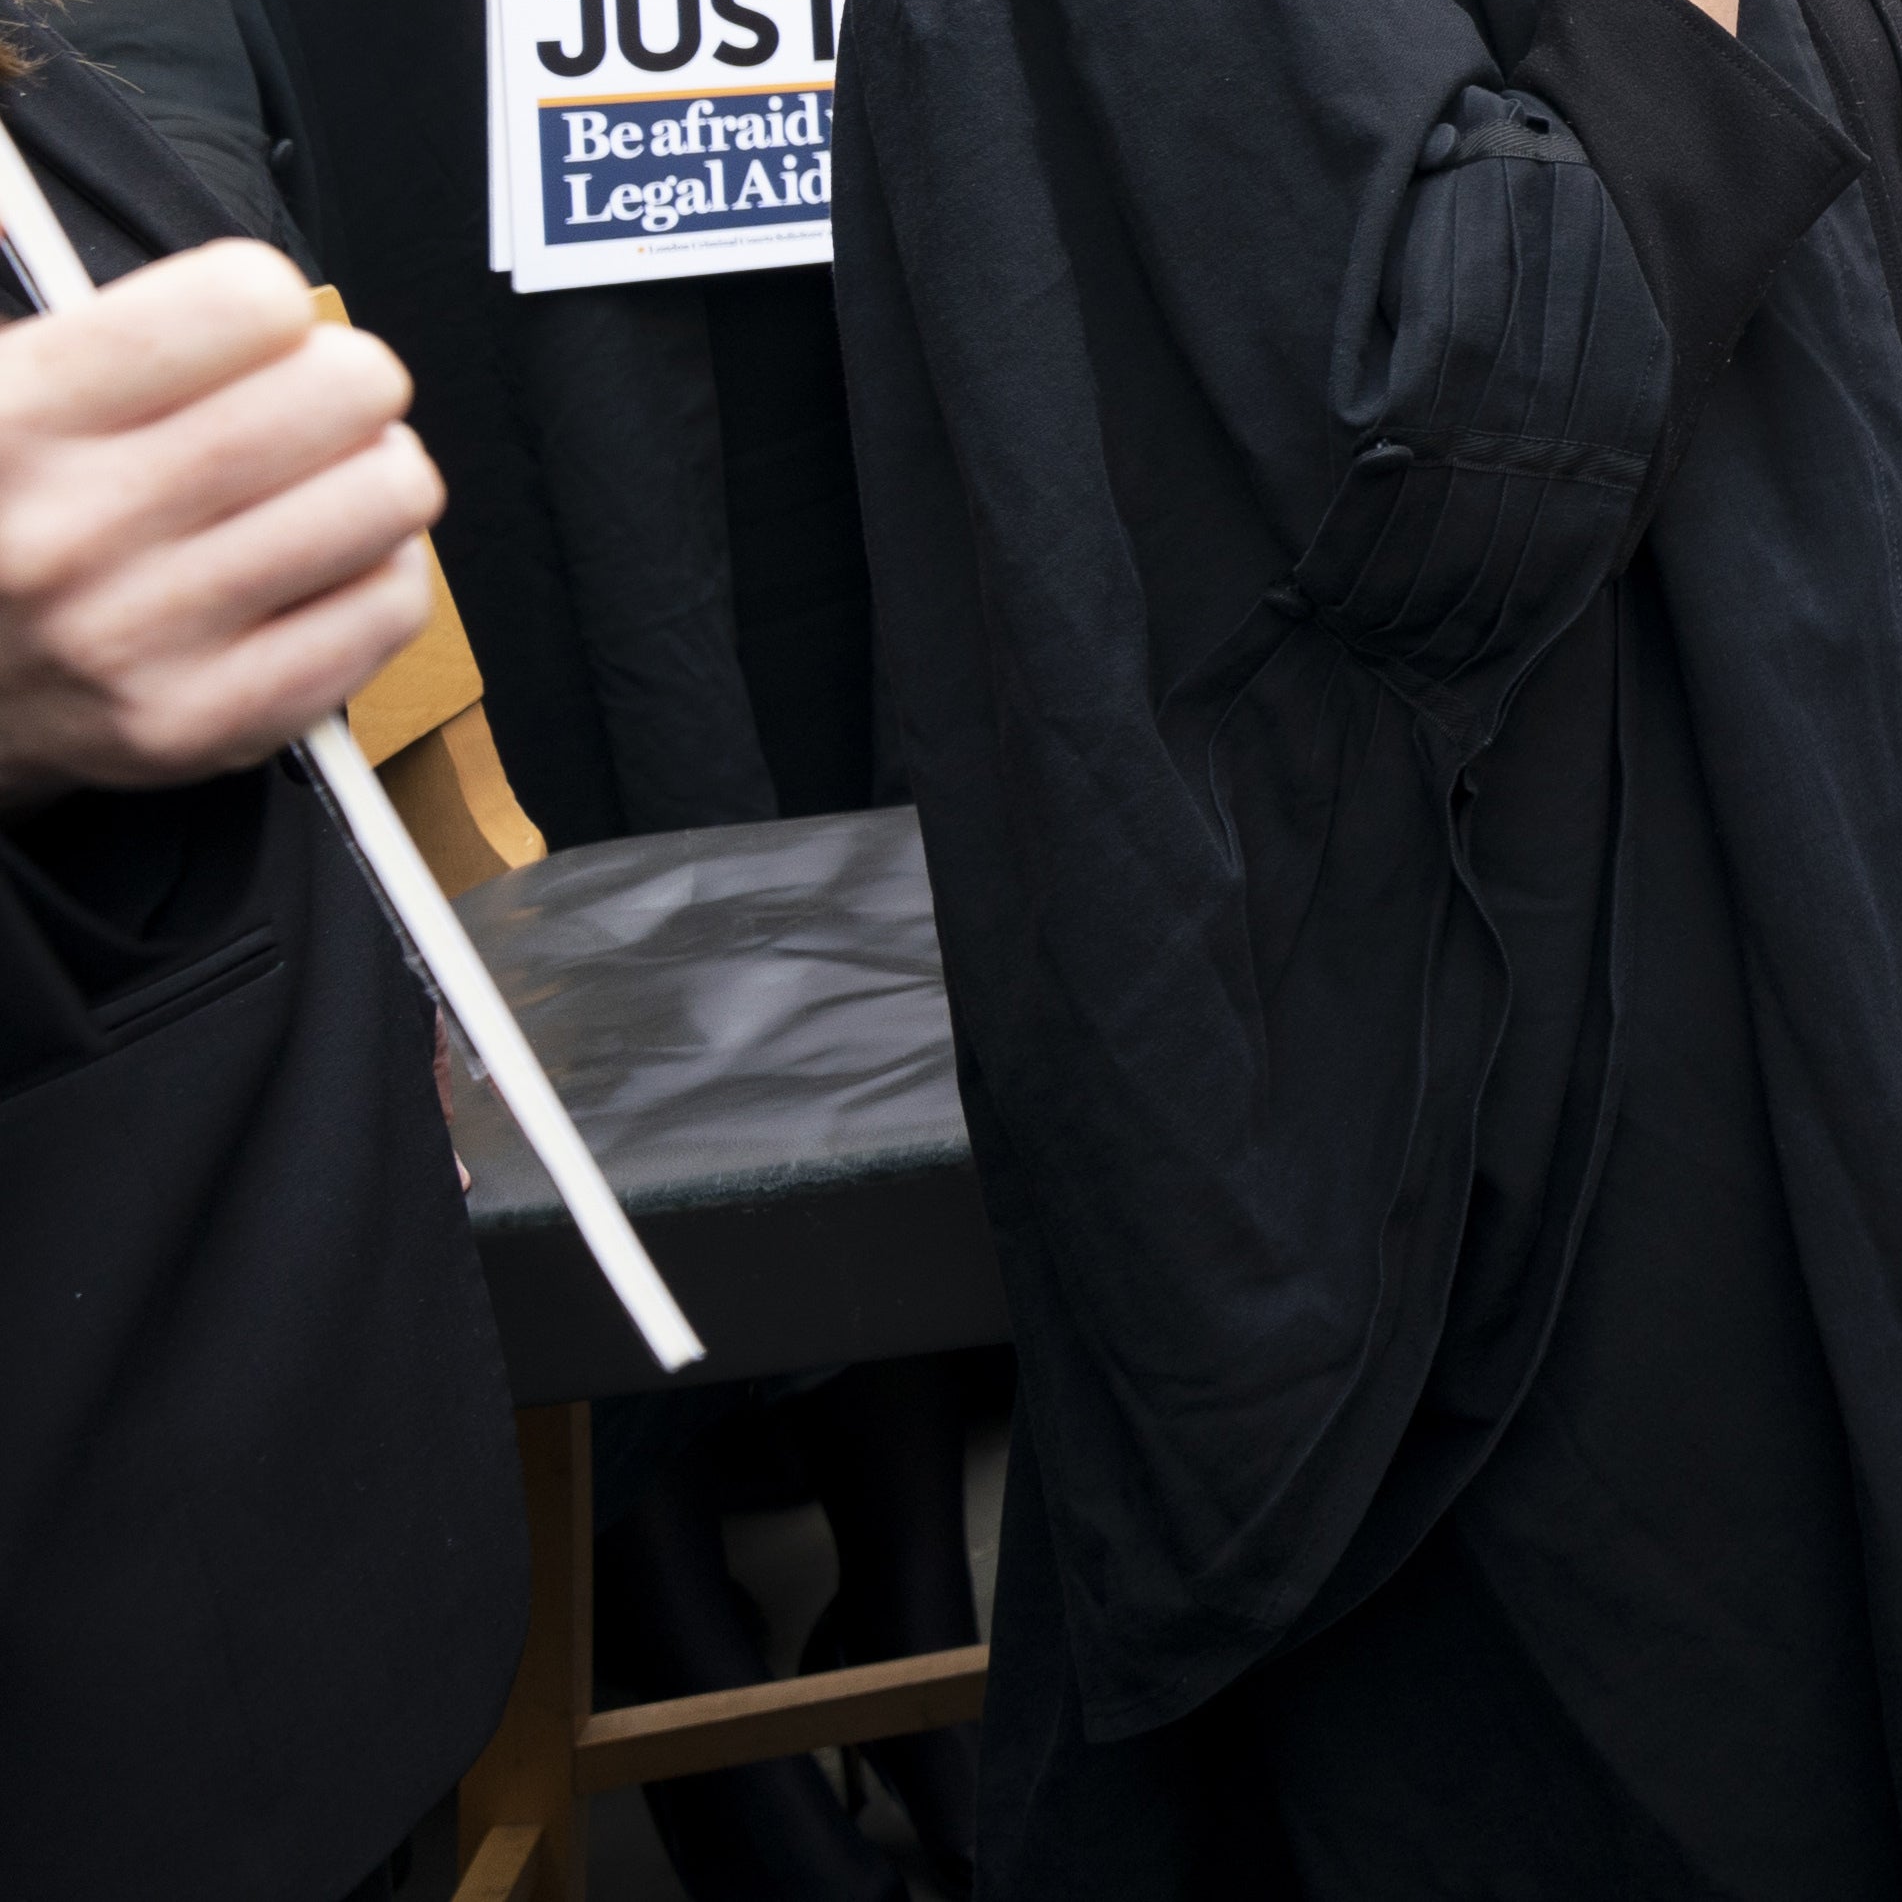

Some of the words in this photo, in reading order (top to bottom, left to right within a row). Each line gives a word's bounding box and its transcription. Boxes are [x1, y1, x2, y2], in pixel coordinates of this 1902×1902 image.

[561, 110, 645, 164] Be
[649, 92, 825, 158] afraid
[563, 158, 730, 232] Legal
[732, 150, 832, 211] Aid
